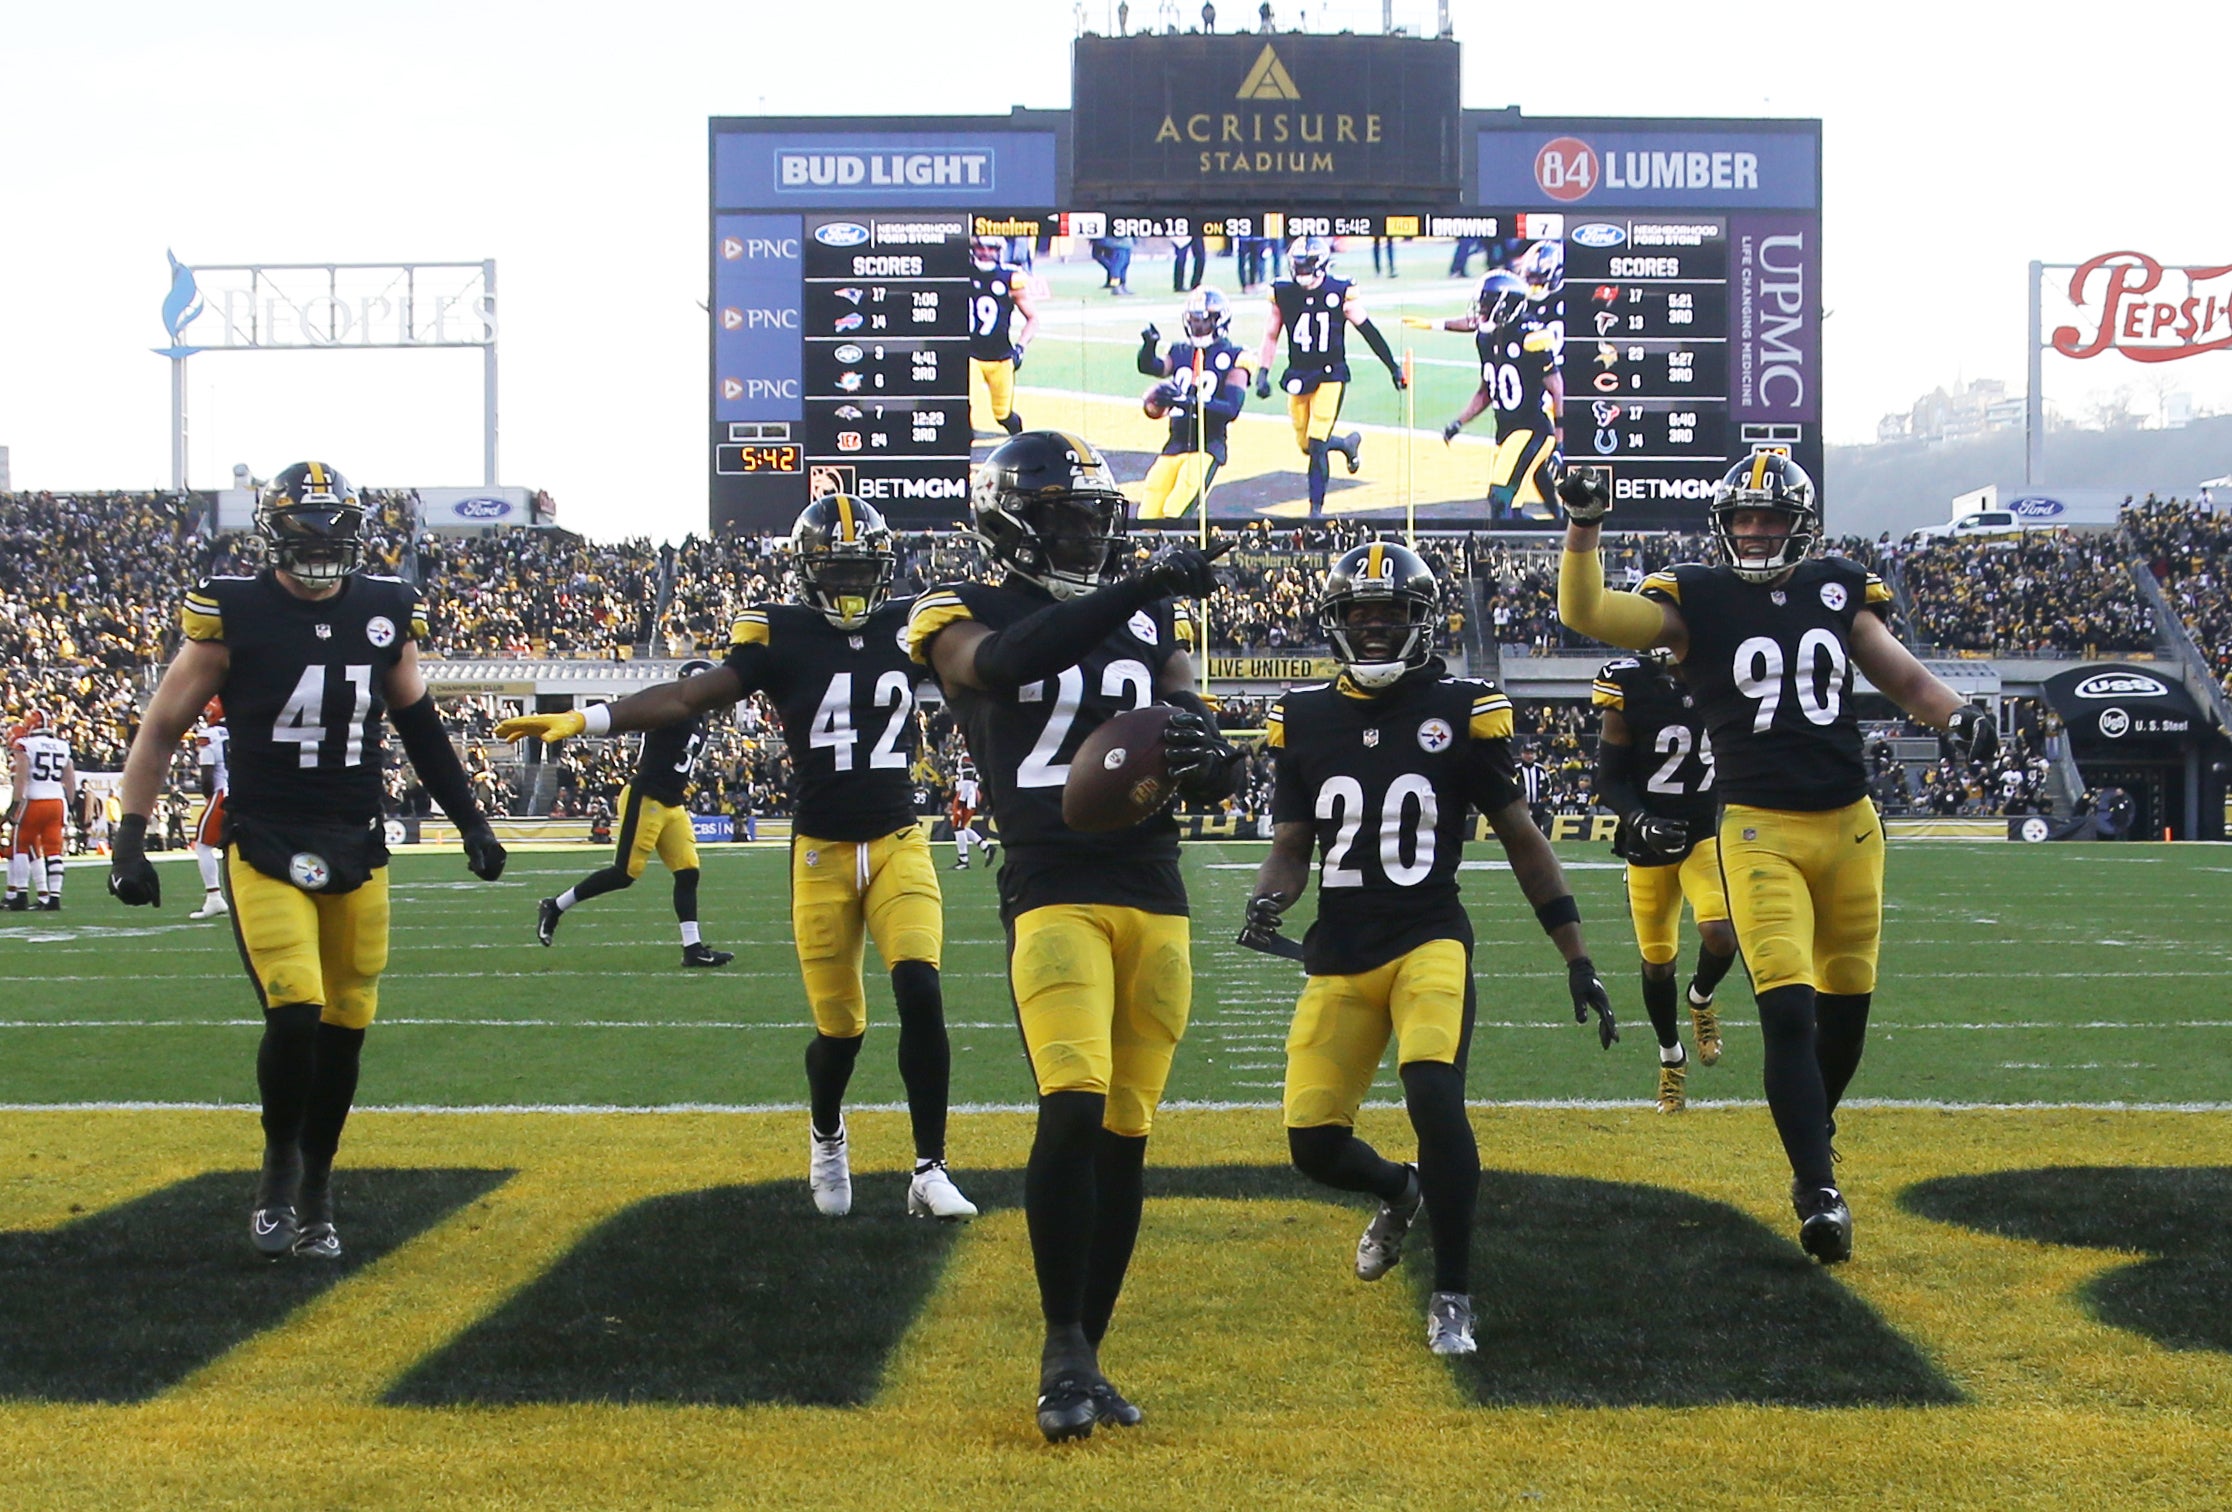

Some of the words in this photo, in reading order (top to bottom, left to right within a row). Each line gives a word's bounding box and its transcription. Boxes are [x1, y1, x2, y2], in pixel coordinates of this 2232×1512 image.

[1155, 114, 1382, 143] ACRISURE
[781, 155, 865, 185] BUD
[870, 155, 986, 185] LIGHT
[1199, 151, 1335, 172] STADIUM
[1542, 150, 1591, 189] 84
[1605, 151, 1759, 189] LUMBER
[974, 216, 1039, 236] Steelers
[1077, 221, 1098, 236] 13
[1203, 222, 1223, 235] ON
[1225, 218, 1252, 236] 33
[1288, 218, 1330, 236] 3RD
[1335, 218, 1371, 236] 5:42
[1431, 217, 1498, 237] BROWNS
[1539, 222, 1549, 236] 7
[747, 238, 798, 259] PNC
[1741, 235, 1753, 266] LIFE
[852, 256, 923, 276] SCORES
[1609, 257, 1679, 277] SCORES
[872, 287, 887, 302] 17
[1629, 288, 1643, 303] 17
[1741, 268, 1753, 340] CHANGING
[219, 287, 500, 347] PEOPLES
[747, 308, 798, 329] PNC
[871, 315, 887, 329] 14
[1759, 231, 1804, 408] UPMC
[1293, 311, 1330, 353] 41
[1741, 342, 1753, 407] MEDICINE
[747, 379, 798, 399] PNC
[1629, 405, 1643, 420] 17
[871, 433, 889, 447] 24
[1628, 433, 1644, 448] 14
[742, 447, 795, 472] 5:42
[301, 472, 333, 494] 41
[858, 478, 966, 499] BETMGM
[1615, 478, 1723, 500] BETMGM
[1740, 471, 1775, 490] 90
[461, 499, 504, 518] Ford
[2016, 498, 2058, 516] Ford
[831, 520, 865, 542] 42
[1354, 557, 1395, 579] 20
[1207, 659, 1244, 677] LIVE
[1250, 659, 1312, 677] UNITED
[1732, 627, 1847, 734] 90
[272, 665, 372, 768] 41
[809, 670, 912, 772] 42
[32, 752, 65, 782] 55
[1315, 773, 1438, 888] 20
